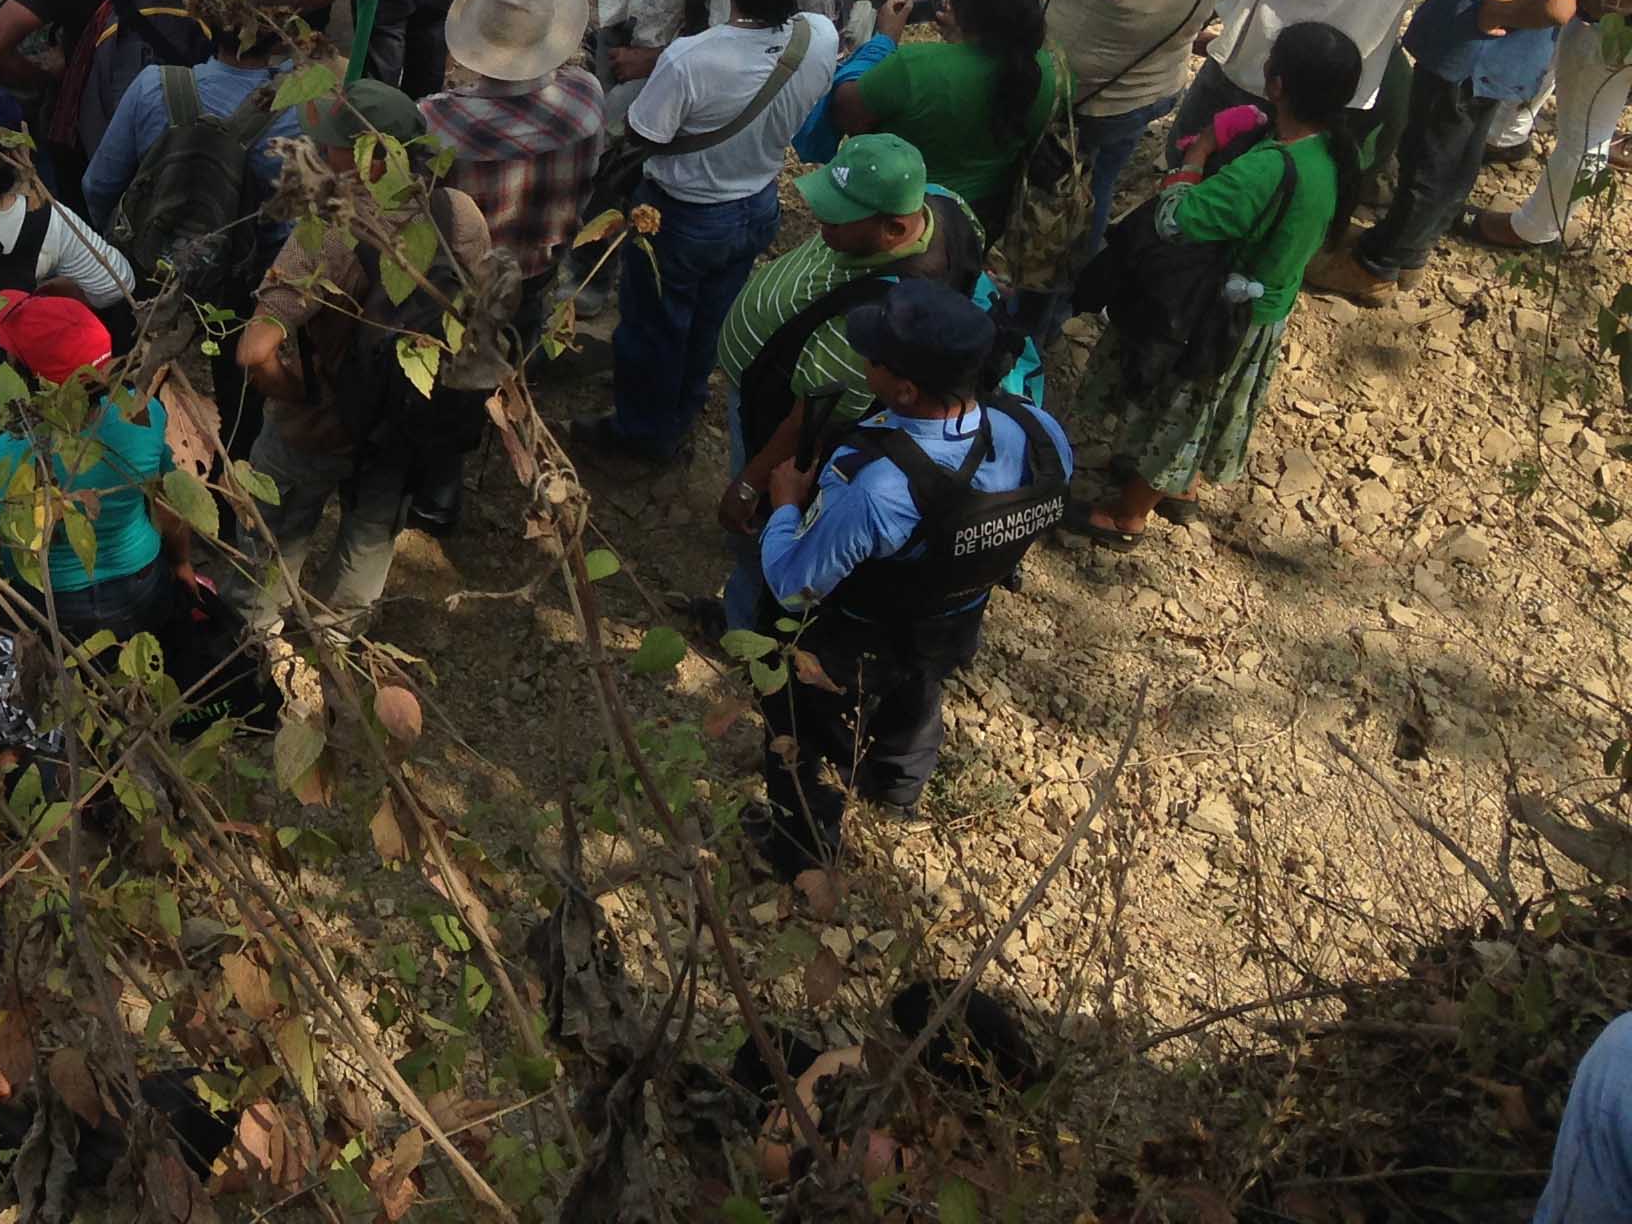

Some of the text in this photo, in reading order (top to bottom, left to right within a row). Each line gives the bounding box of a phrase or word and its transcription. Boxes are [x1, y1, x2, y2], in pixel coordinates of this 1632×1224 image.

[954, 509, 1064, 556] DE HONDURAS
[955, 495, 1065, 544] POLICIA NACIONAL
